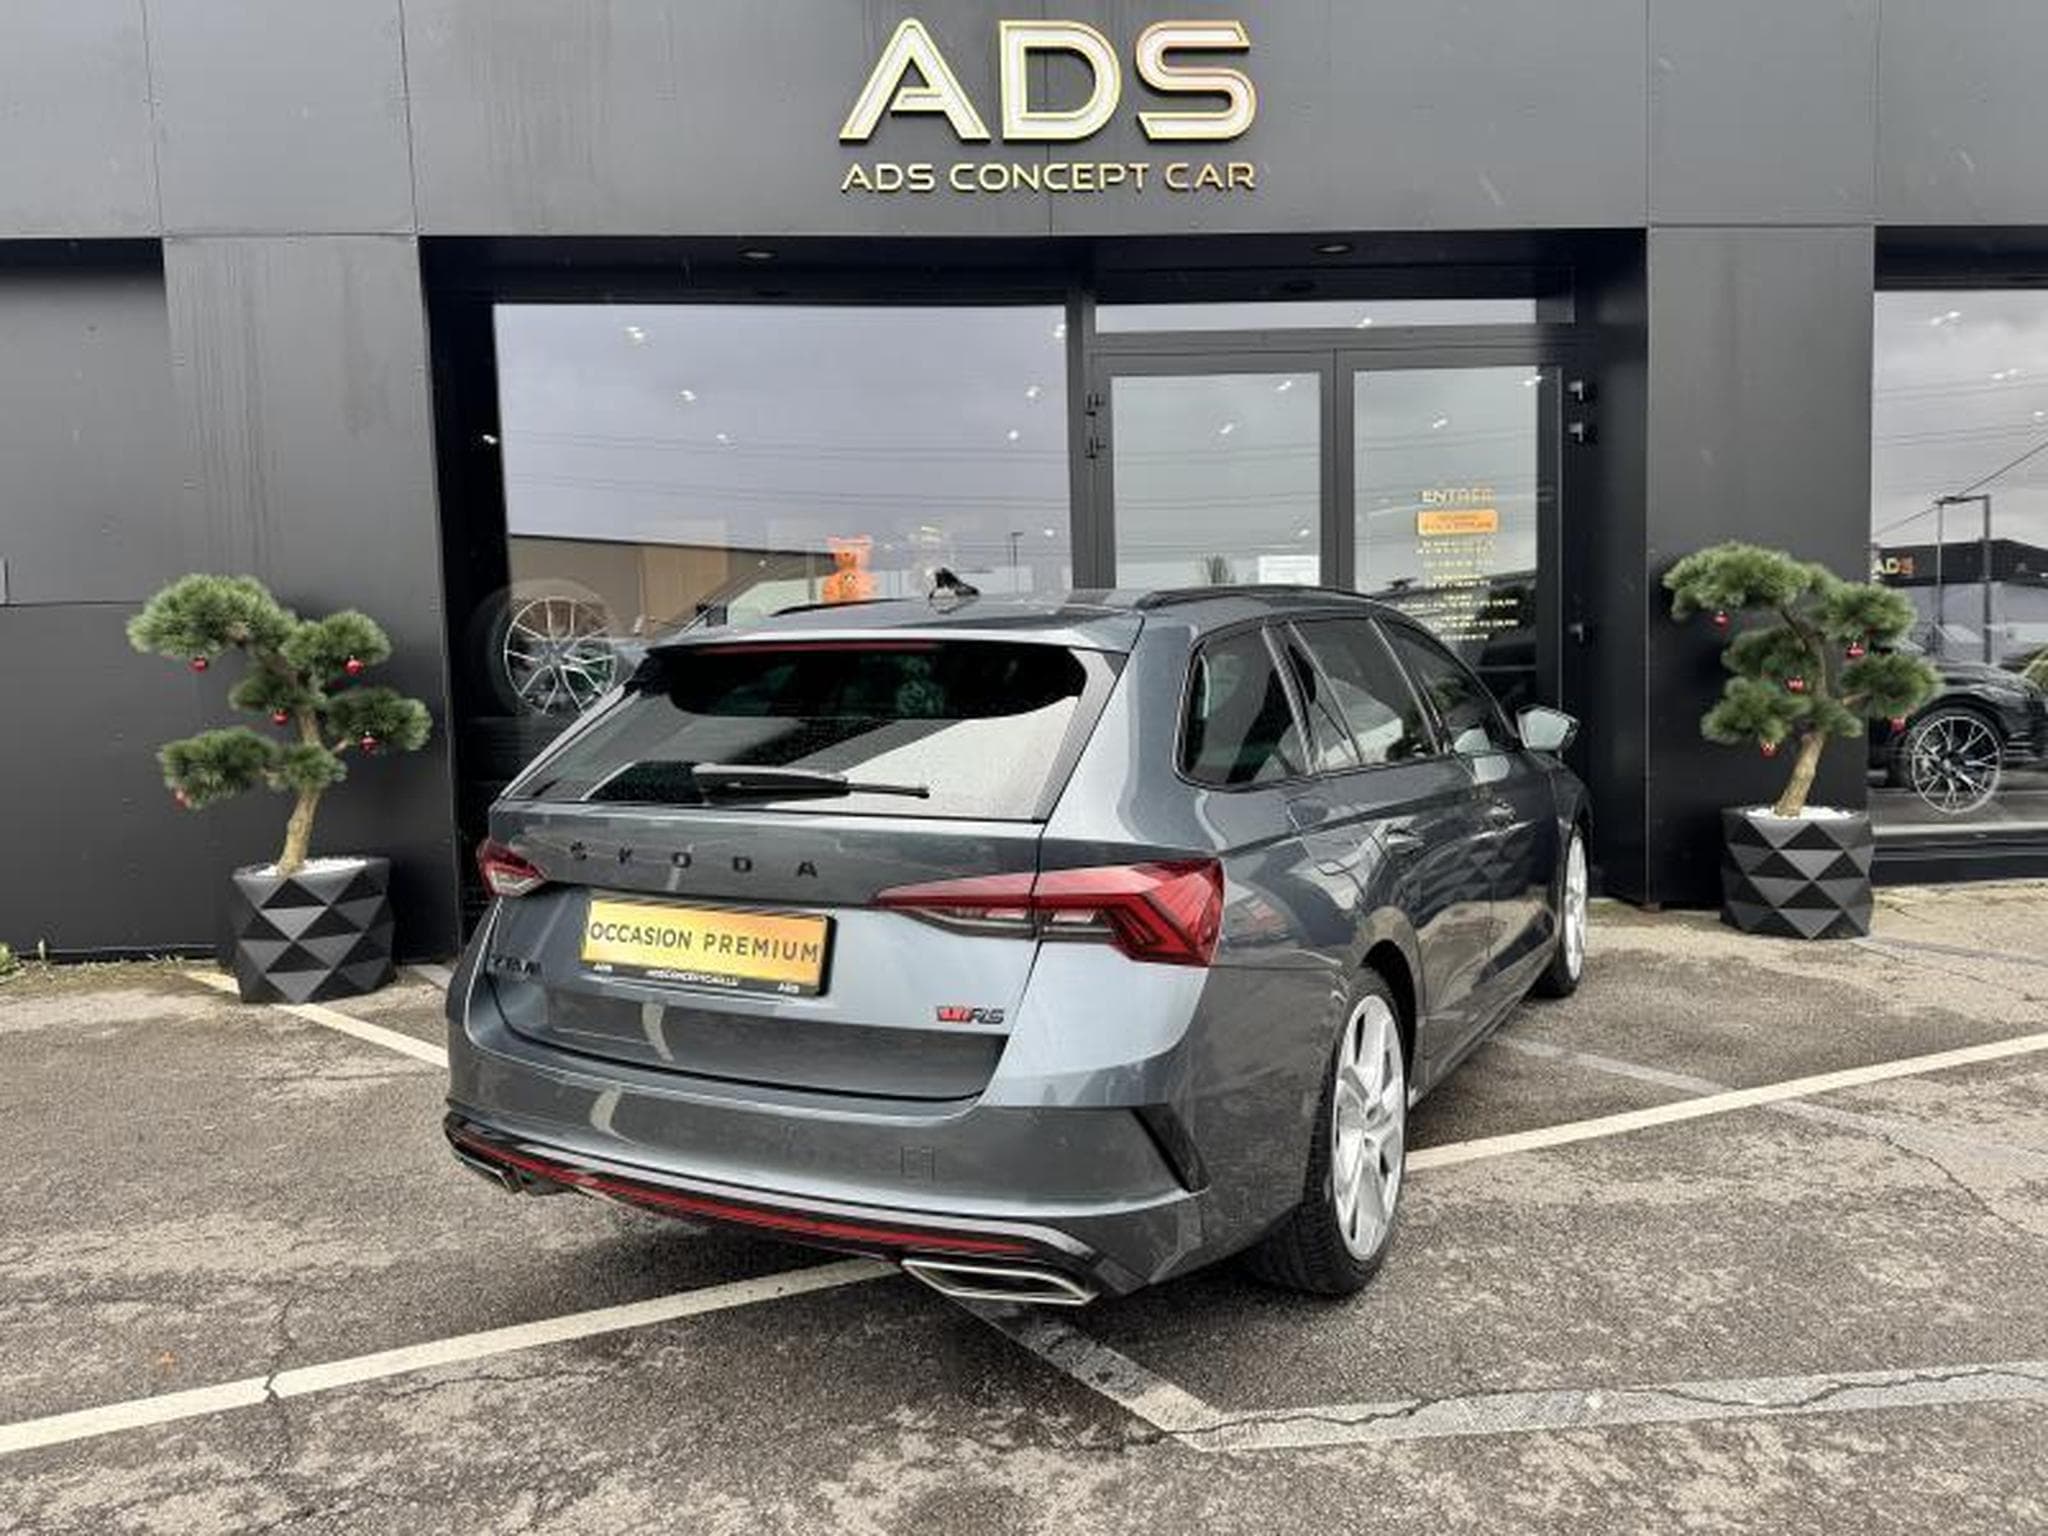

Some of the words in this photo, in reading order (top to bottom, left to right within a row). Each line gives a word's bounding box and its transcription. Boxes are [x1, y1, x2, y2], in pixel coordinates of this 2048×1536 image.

[839, 17, 1257, 140] ADS
[841, 162, 936, 192] ADS
[949, 162, 1150, 192] CONCEPT
[1165, 162, 1257, 190] CAR
[589, 920, 693, 951] OCCASION
[702, 932, 819, 964] PREMIUM
